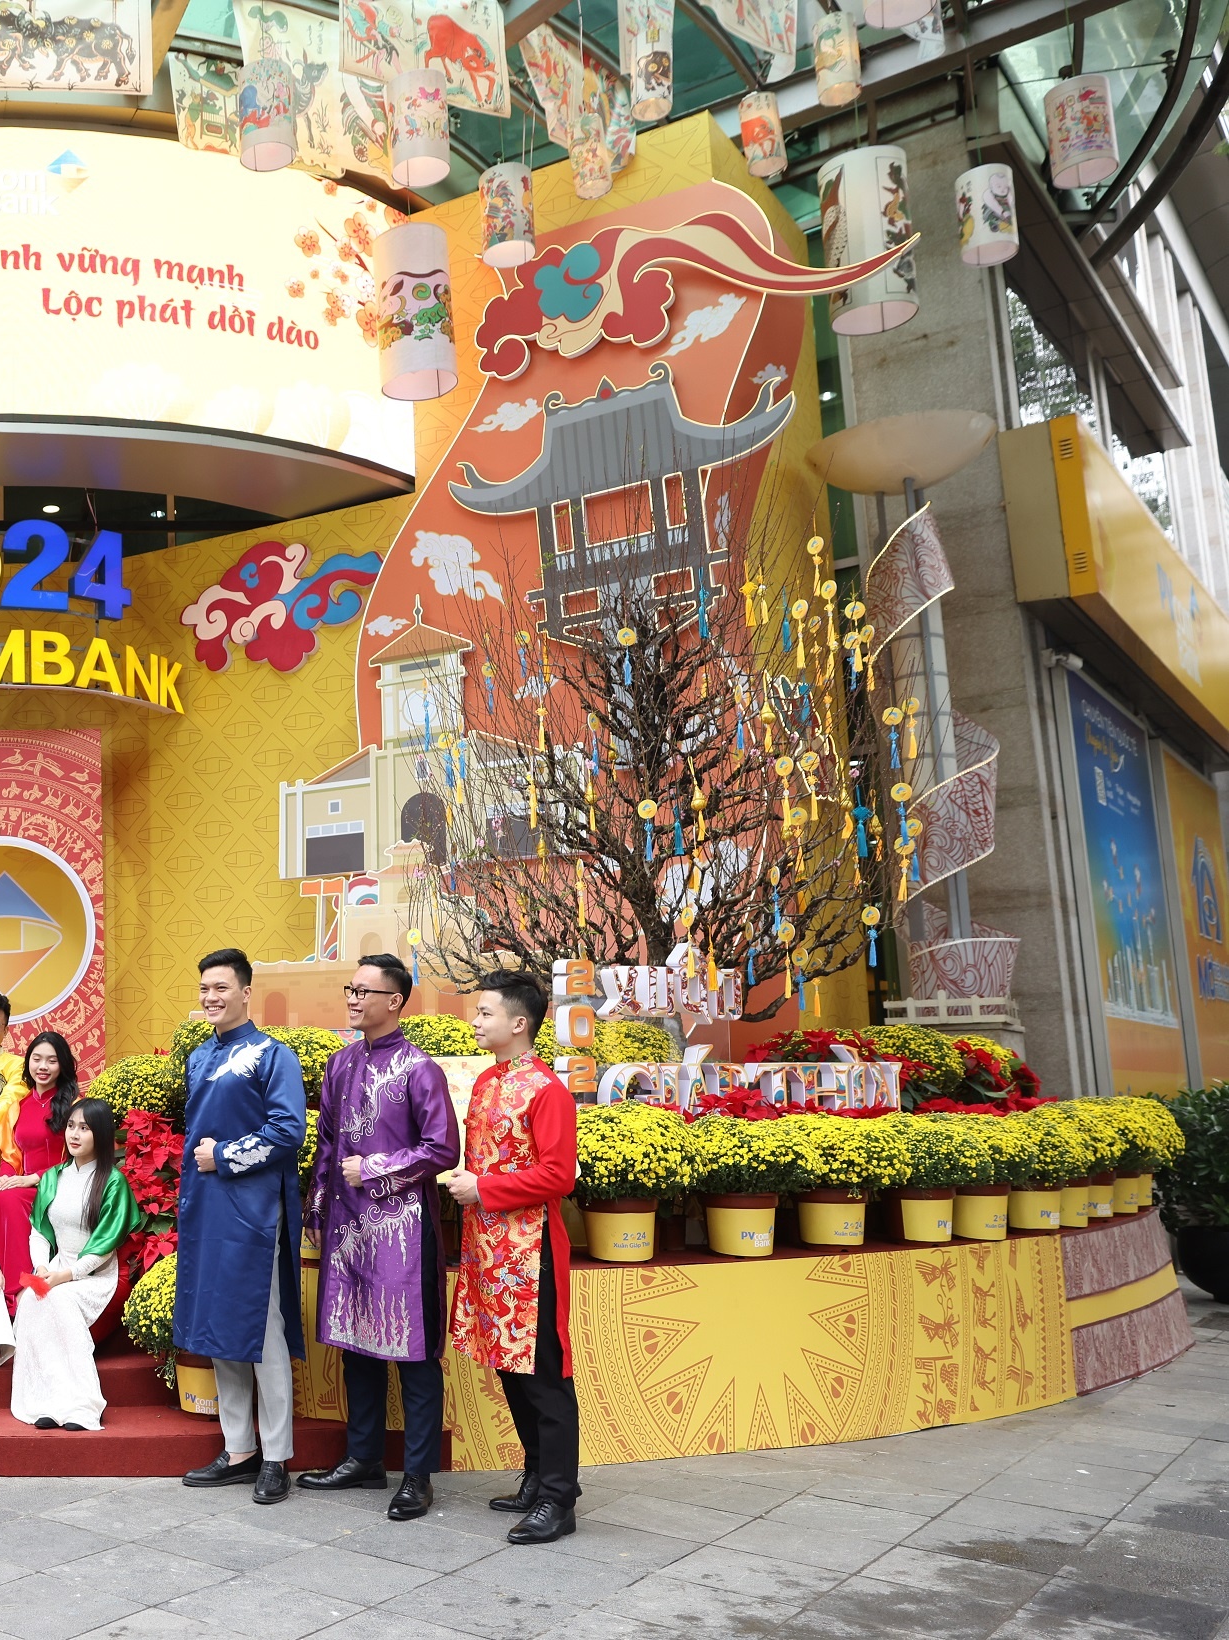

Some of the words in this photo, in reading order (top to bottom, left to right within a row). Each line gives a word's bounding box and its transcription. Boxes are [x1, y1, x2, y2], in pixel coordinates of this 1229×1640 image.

[56, 246, 140, 287] vững
[153, 257, 244, 292] mạnh
[41, 287, 102, 322] Lộc
[115, 294, 195, 330] phát
[207, 303, 257, 337] dồi
[266, 315, 320, 351] dào
[185, 1391, 213, 1407] PVcom
[195, 1404, 217, 1415] Bank
